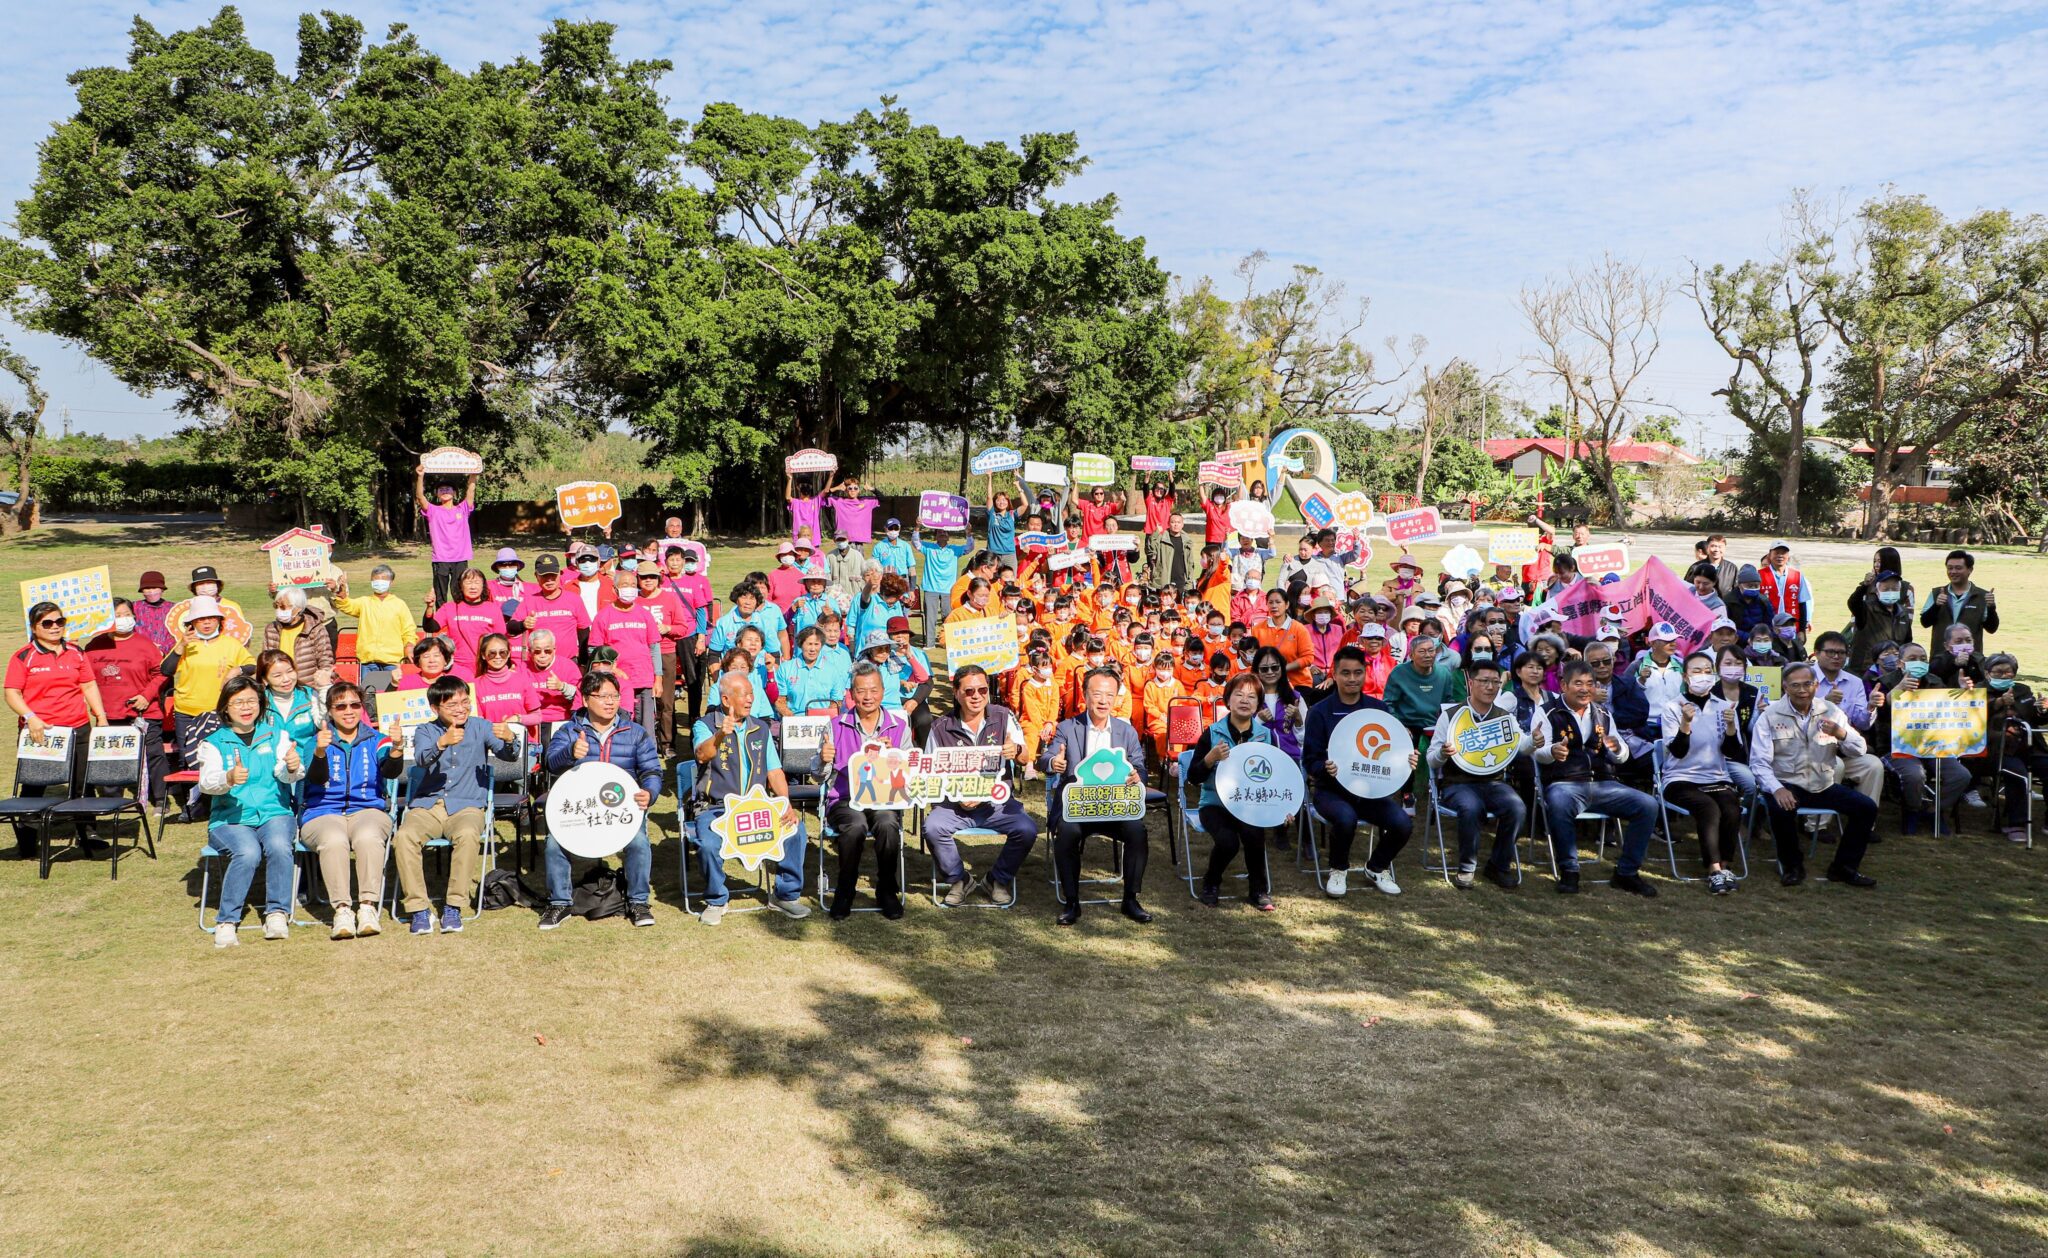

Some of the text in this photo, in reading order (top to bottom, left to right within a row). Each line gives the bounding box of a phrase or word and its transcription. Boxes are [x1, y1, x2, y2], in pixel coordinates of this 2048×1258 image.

[93, 735, 137, 750] 貴賓席
[1458, 722, 1503, 753] 巷弄
[332, 754, 341, 782] 理事長
[908, 750, 1001, 774] 善用長照資源
[1351, 761, 1392, 776] 長期照顧
[1068, 785, 1142, 802] 長照好厝邊
[1229, 786, 1293, 803] 嘉義縣政府
[1068, 801, 1141, 818] 生活好安心
[736, 810, 771, 832] 日間
